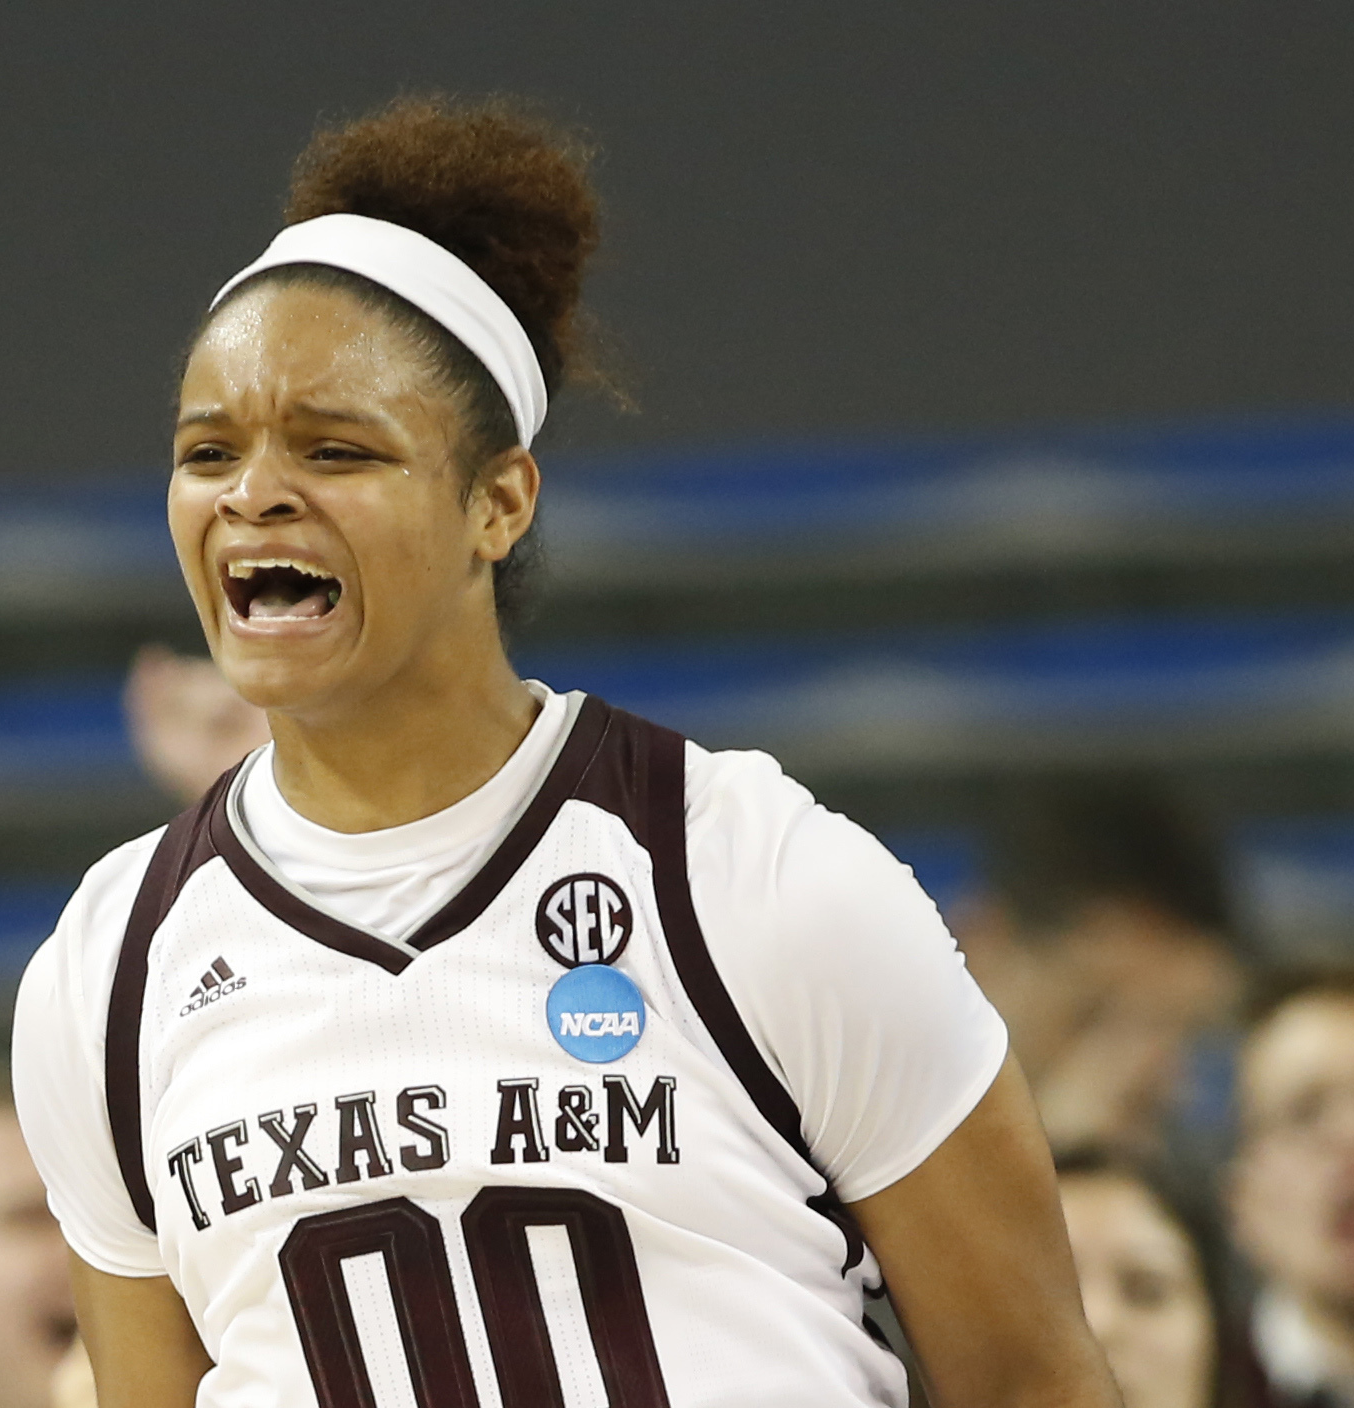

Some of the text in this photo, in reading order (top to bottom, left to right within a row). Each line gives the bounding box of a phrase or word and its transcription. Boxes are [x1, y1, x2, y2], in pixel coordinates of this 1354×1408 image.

[545, 880, 625, 963] SEC
[179, 976, 247, 1018] adidas
[559, 1011, 640, 1037] NCAA
[168, 1074, 681, 1231] TEXAS A&M
